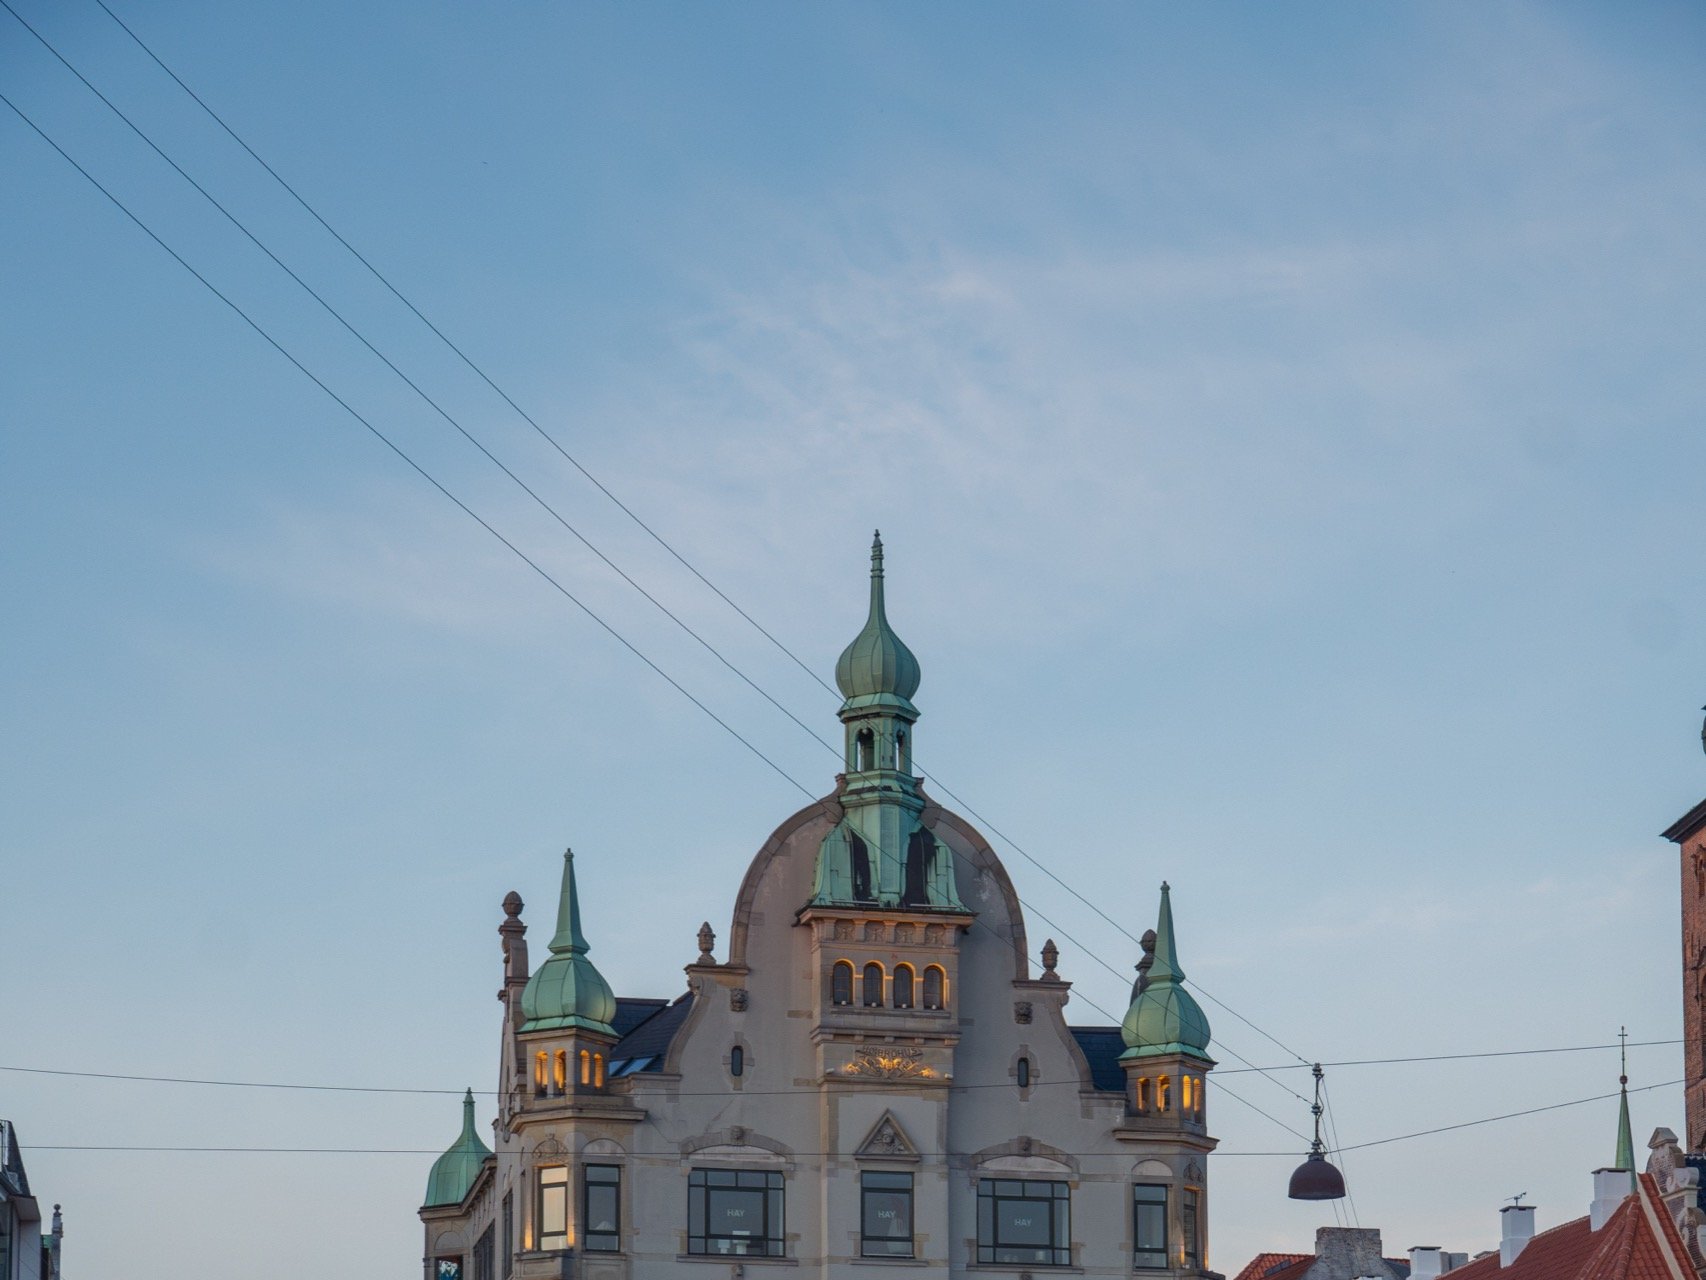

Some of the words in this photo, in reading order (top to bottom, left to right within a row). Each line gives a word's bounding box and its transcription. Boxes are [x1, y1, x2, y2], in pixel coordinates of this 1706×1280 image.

[727, 1209, 745, 1217] HAY
[878, 1211, 896, 1219] HAY
[1014, 1218, 1032, 1227] HAY
